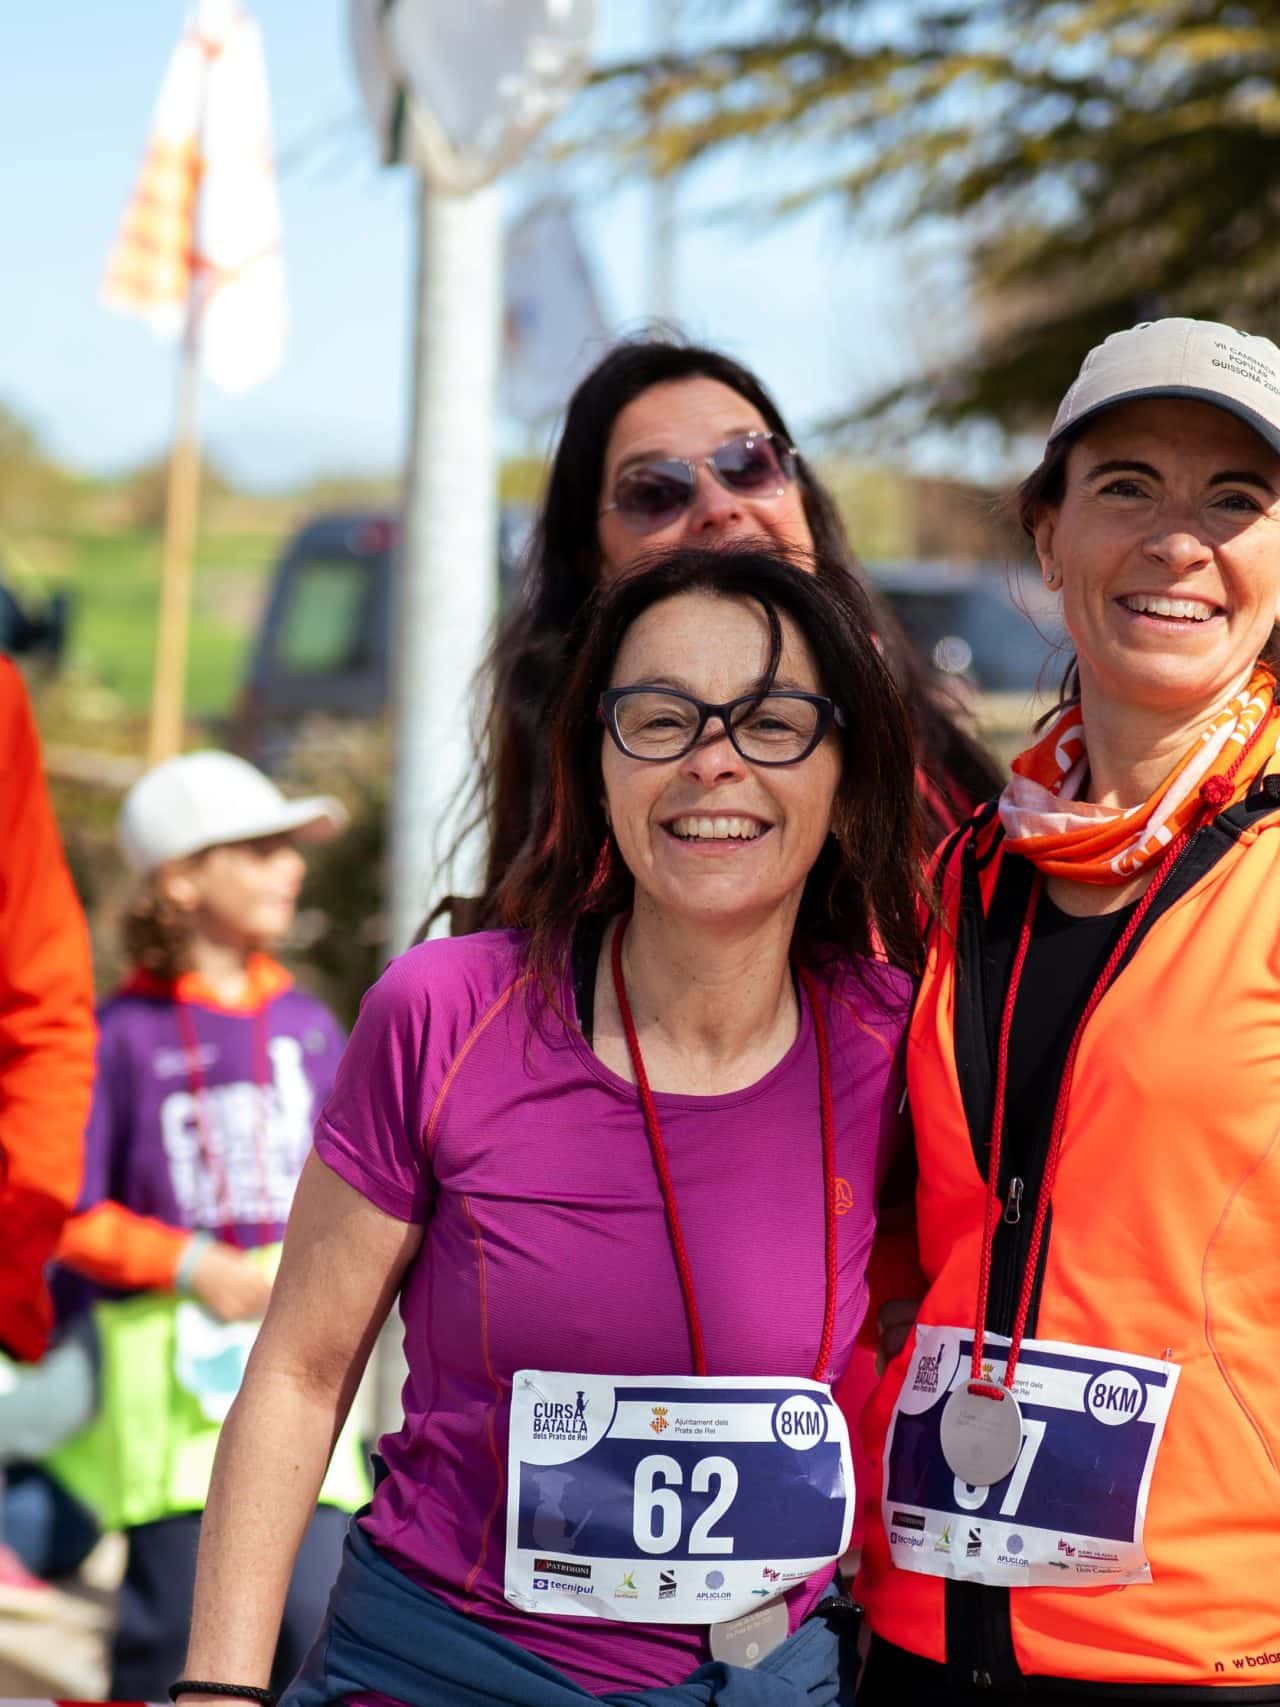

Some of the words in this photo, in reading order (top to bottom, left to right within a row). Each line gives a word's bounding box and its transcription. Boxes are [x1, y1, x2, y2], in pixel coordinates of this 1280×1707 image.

[1212, 359, 1261, 384] GUISSONA
[1229, 354, 1268, 378] POPULAR
[1092, 1383, 1139, 1414] 8KM
[534, 1402, 585, 1420] CURSA
[533, 1418, 588, 1434] BATALLA
[781, 1410, 820, 1437] 8KM
[549, 1432, 566, 1441] Prats
[633, 1454, 739, 1554] 62
[551, 1580, 594, 1596] tecnipul
[1214, 1660, 1244, 1672] nw
